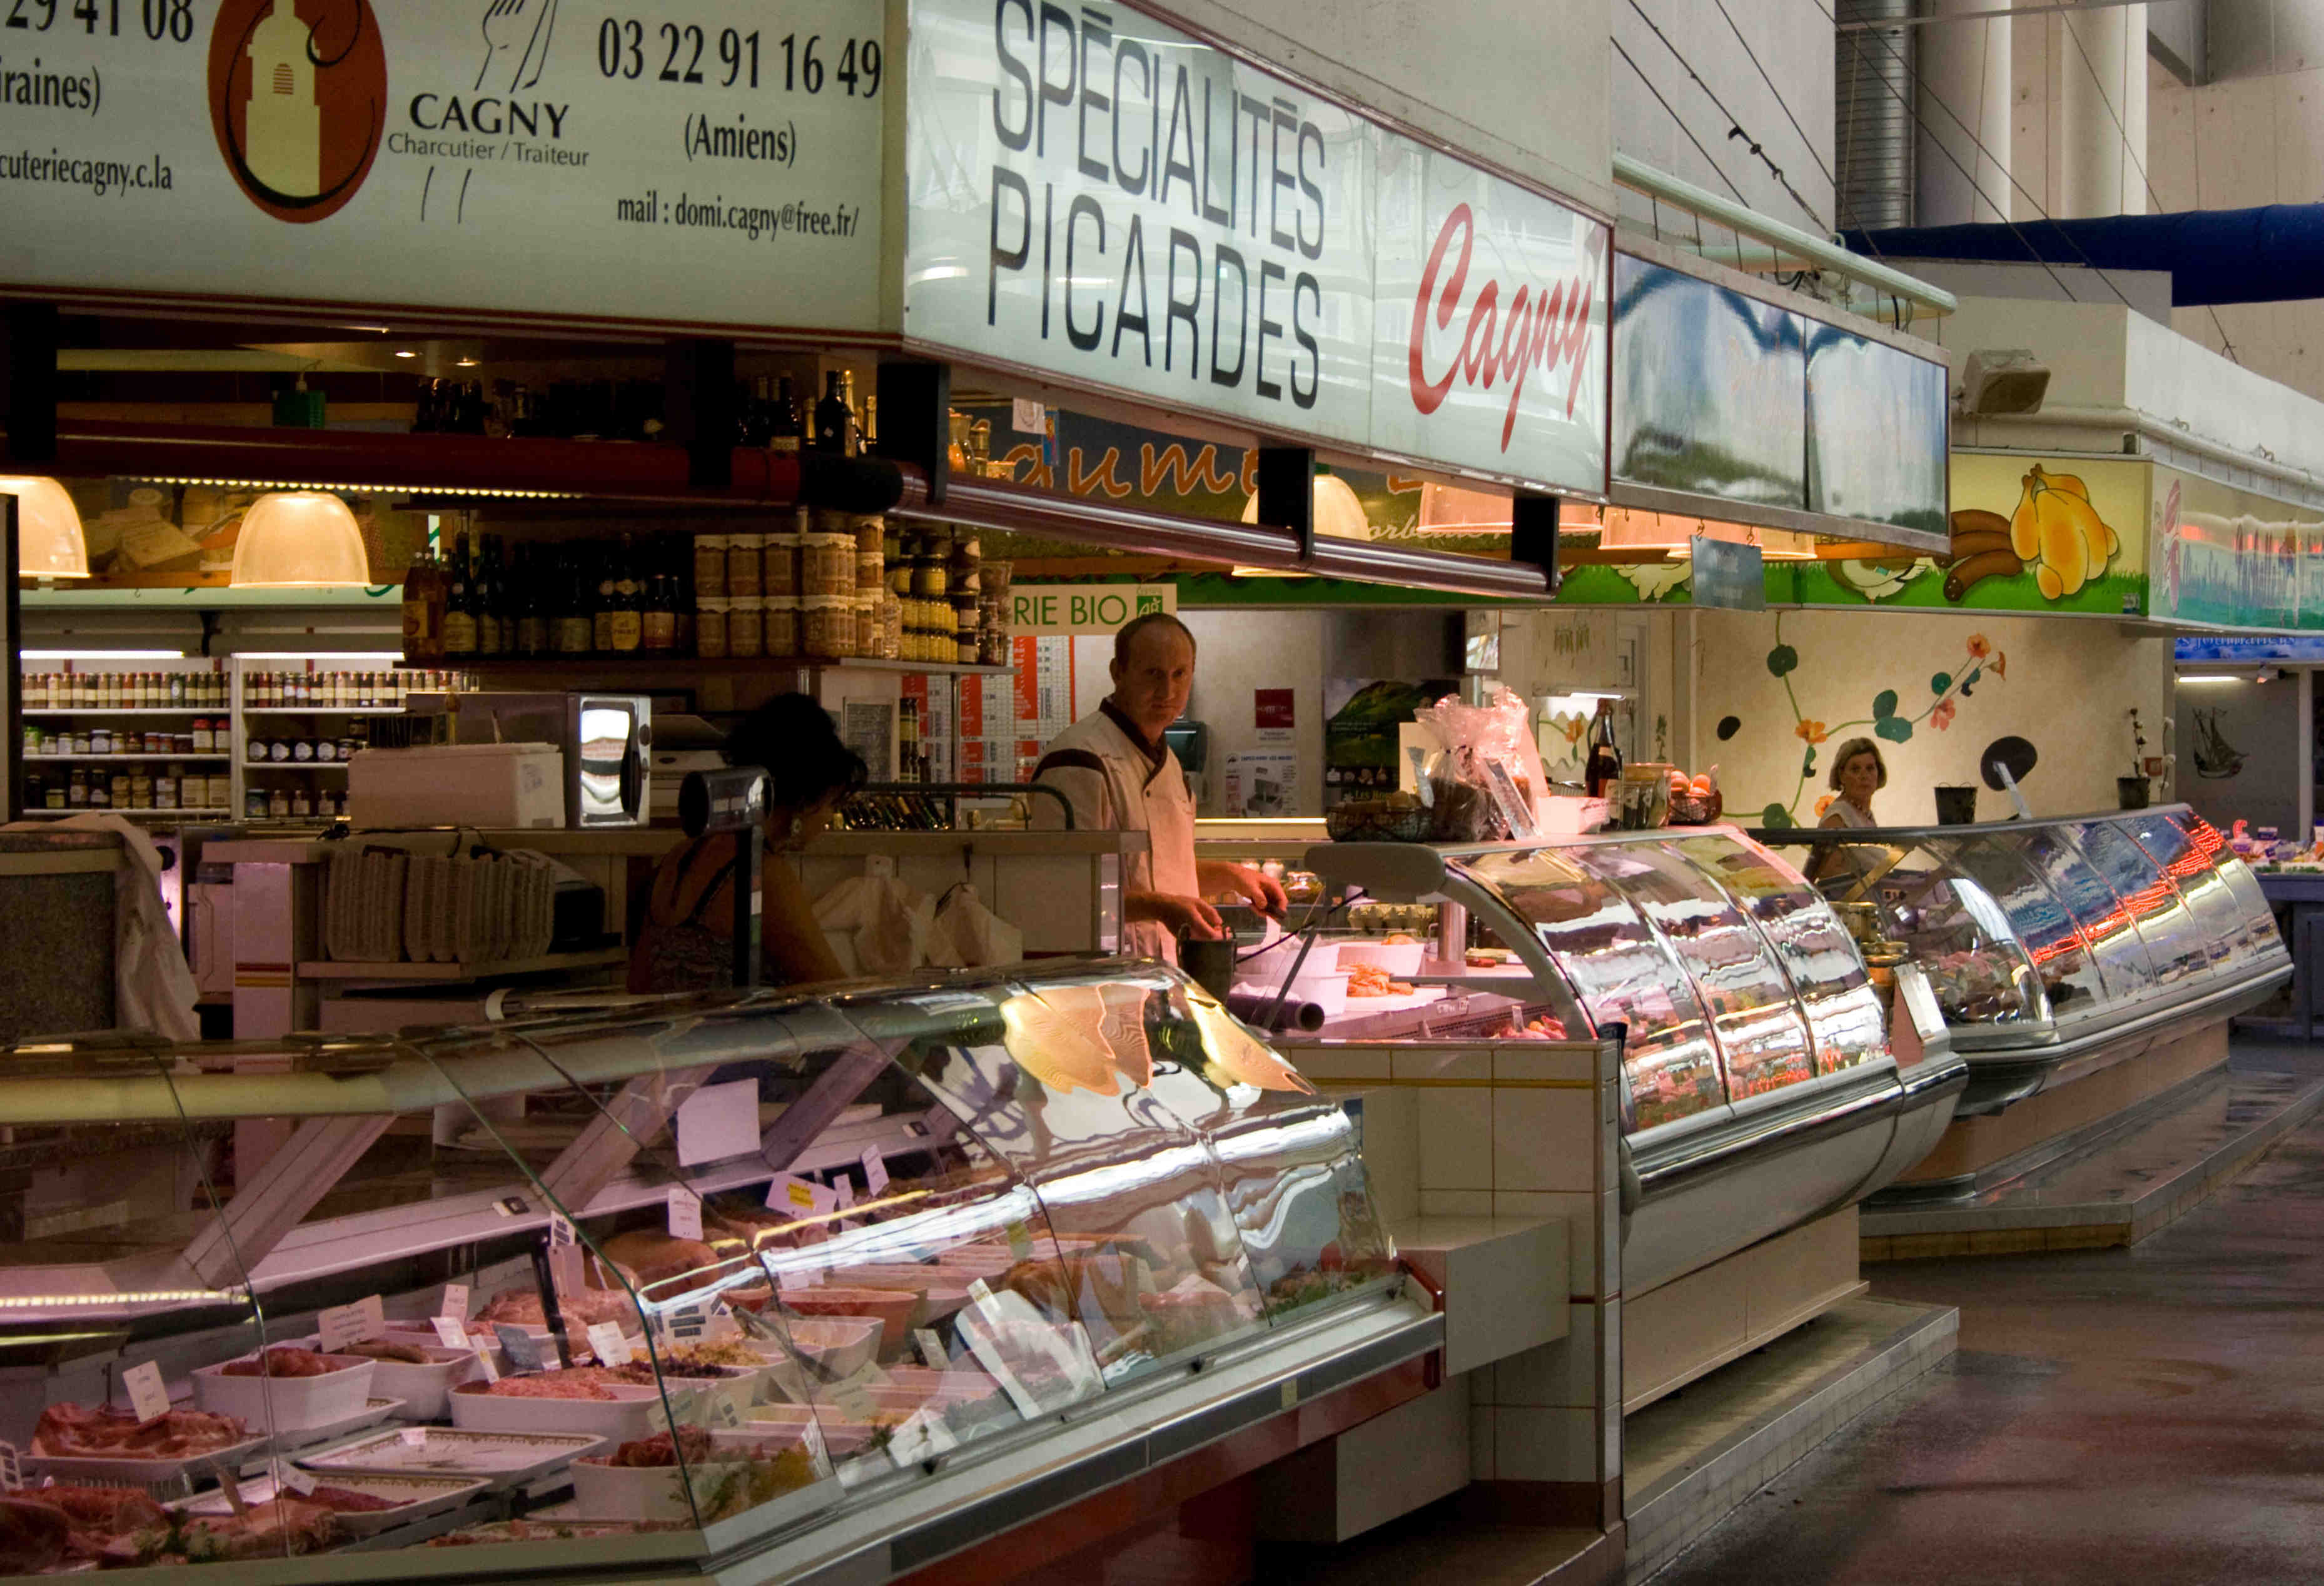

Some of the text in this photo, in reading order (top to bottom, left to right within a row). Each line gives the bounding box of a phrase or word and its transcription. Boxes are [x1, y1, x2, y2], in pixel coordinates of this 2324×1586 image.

[142, 0, 194, 43] 08
[598, 18, 881, 98] 03 22 91 16 49
[0, 55, 101, 117] raines)
[410, 93, 569, 139] CAGNY
[684, 112, 797, 169] (Amiens)
[388, 133, 495, 160] Charcutier
[512, 142, 589, 167] Traiteur
[617, 191, 657, 225] mail
[675, 193, 859, 241] domi.cagny@free.fr/
[987, 164, 1321, 410] PICARDES
[1409, 201, 1594, 454] Cagny
[1070, 595, 1127, 625] BIO
